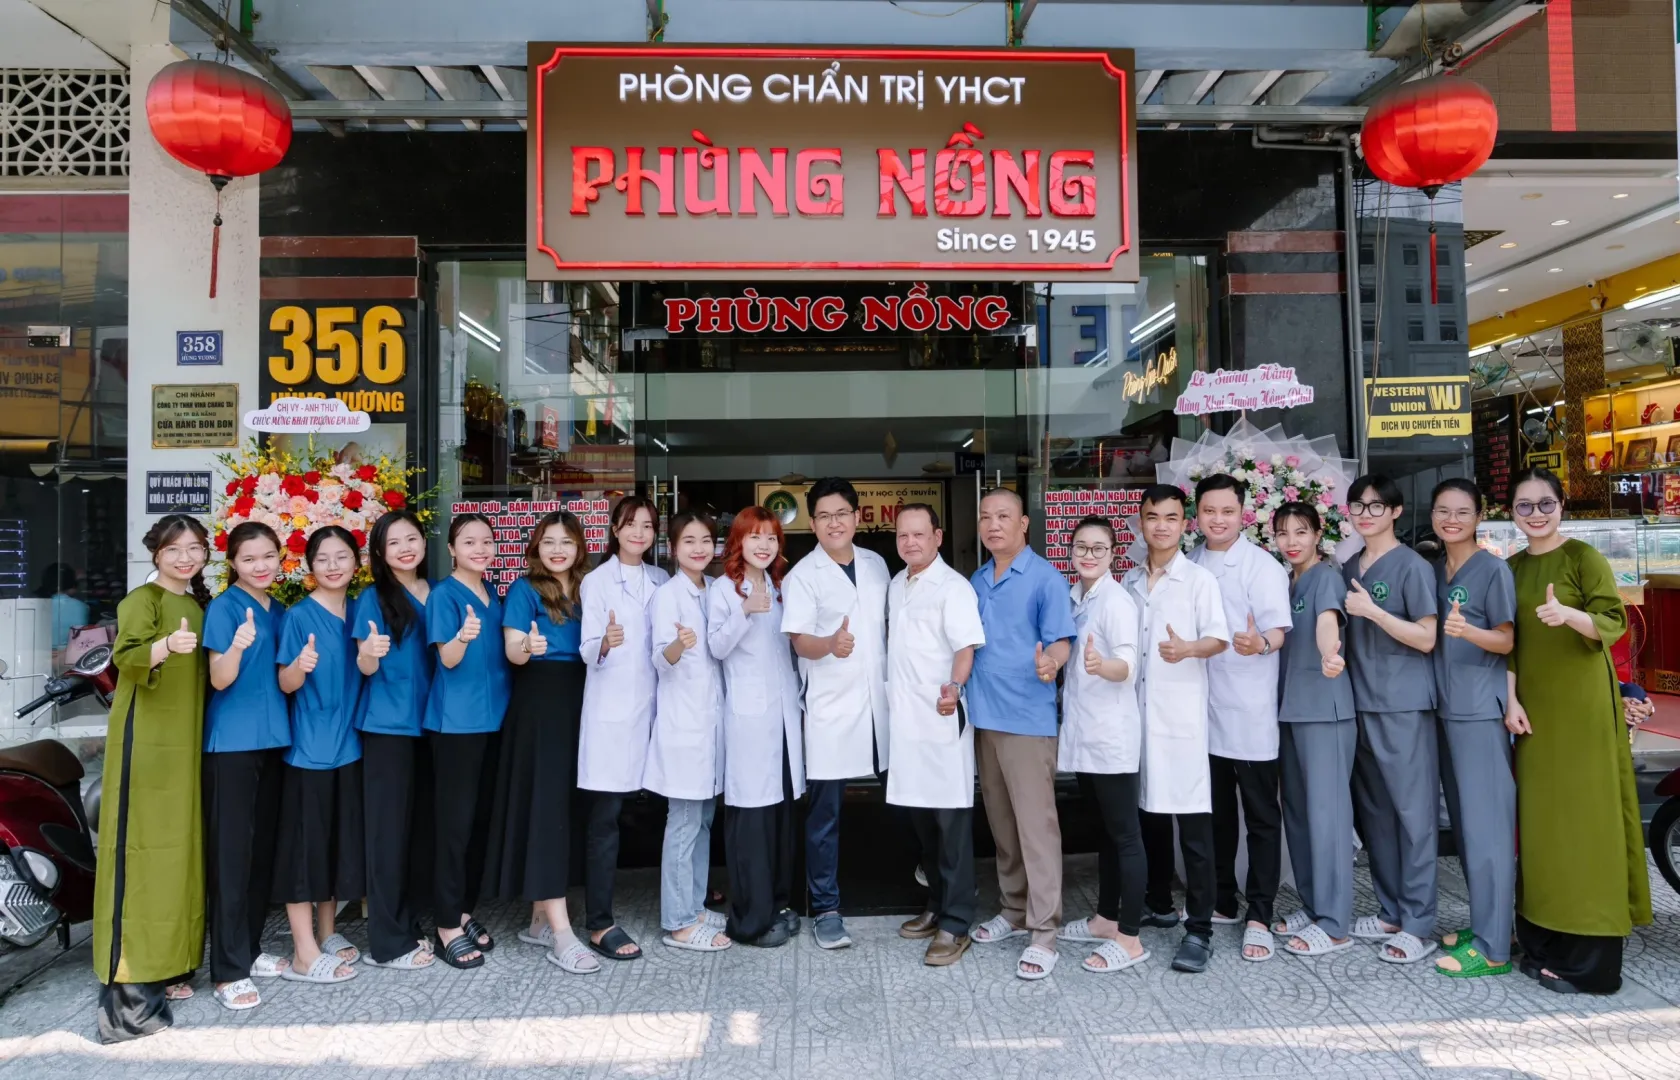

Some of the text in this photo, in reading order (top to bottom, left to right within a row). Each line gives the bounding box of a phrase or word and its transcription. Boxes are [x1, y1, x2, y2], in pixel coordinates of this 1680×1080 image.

[619, 61, 1026, 110] PHÒNG CHẨN TRỊ YHCT
[569, 121, 1097, 218] PHÙNG NỒNG
[937, 228, 1097, 252] Since 1945
[663, 282, 1012, 333] PHÙNG NỒNG
[183, 336, 216, 353] 358
[268, 305, 406, 385] 356
[1371, 386, 1426, 397] WESTERN
[277, 404, 288, 414] CHỊ
[304, 404, 319, 412] ANH
[1390, 402, 1426, 412] UNION
[198, 420, 215, 428] BON
[216, 420, 233, 428] BON
[1381, 421, 1399, 432] DỊCH
[1400, 420, 1410, 432] VỤ
[1412, 416, 1441, 430] CHUYỂN
[166, 494, 174, 504] XE
[876, 490, 894, 499] HỌC
[1064, 505, 1078, 516] EM
[499, 542, 522, 554] KINH
[505, 556, 524, 568] VAI
